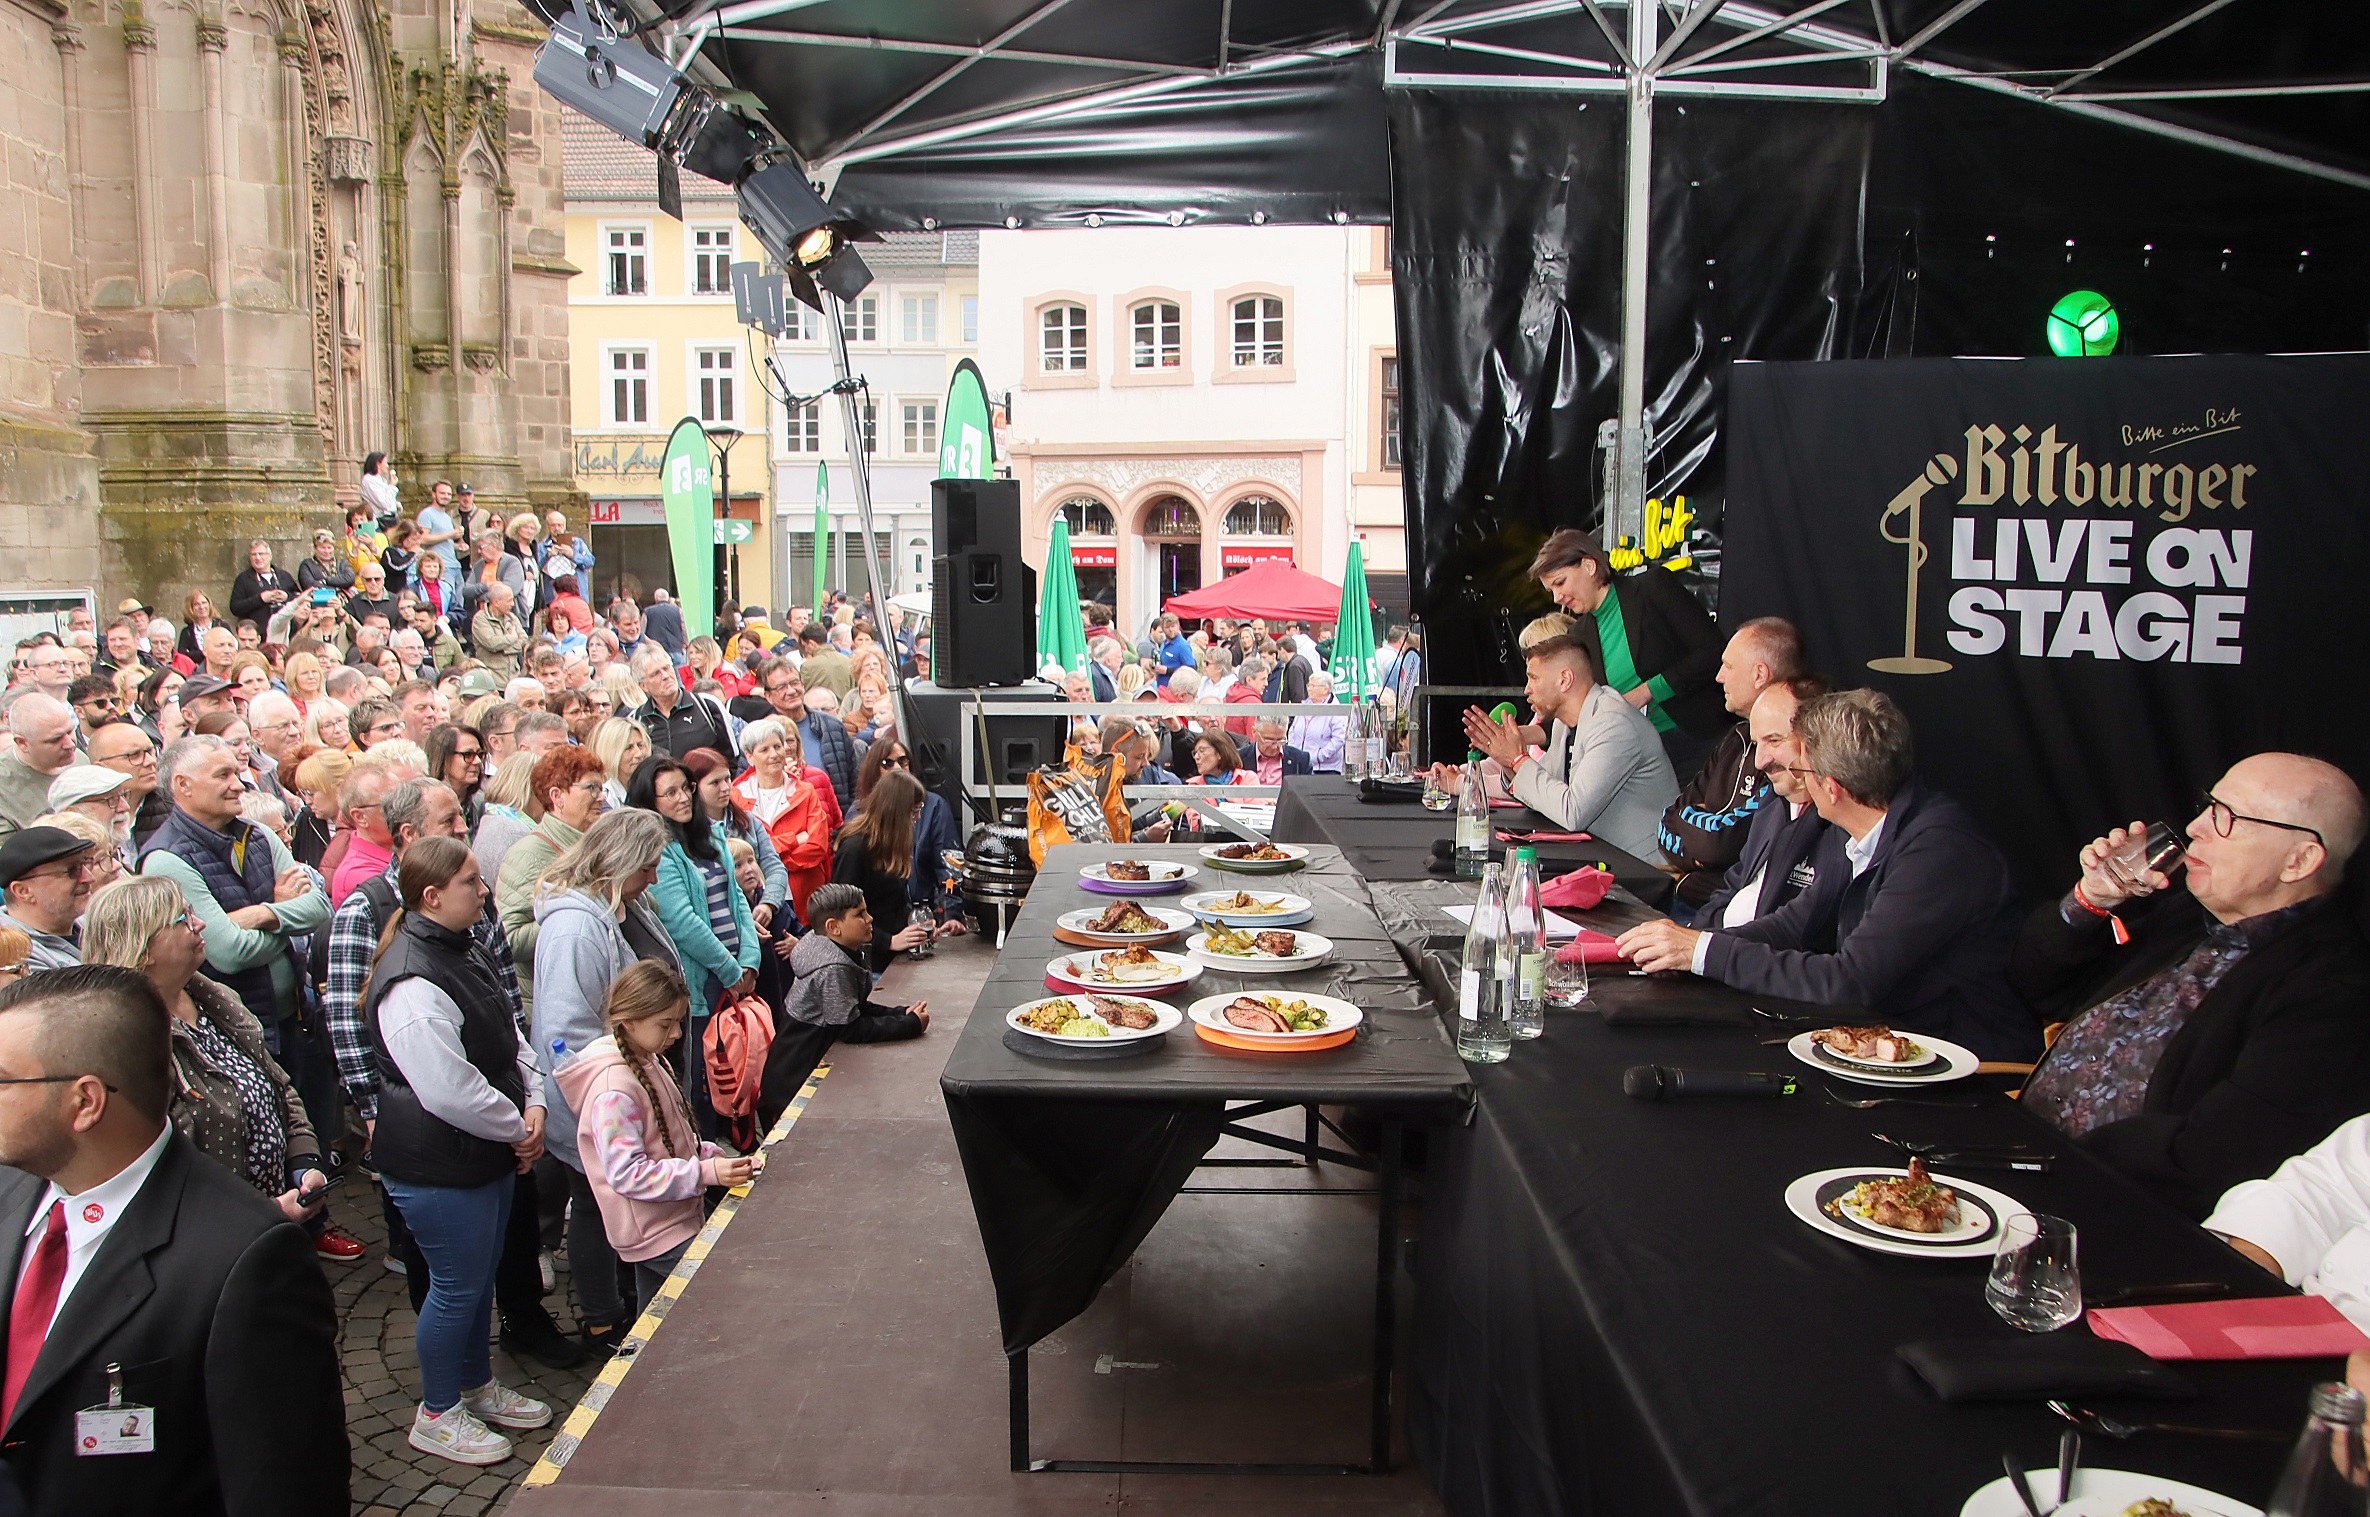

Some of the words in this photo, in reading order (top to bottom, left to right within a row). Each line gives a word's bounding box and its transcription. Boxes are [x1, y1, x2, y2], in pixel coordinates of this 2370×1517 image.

[579, 443, 618, 470] Carl
[623, 443, 663, 471] Au
[2121, 424, 2164, 446] Bitte
[2172, 424, 2200, 436] ein
[2205, 407, 2242, 429] Bit
[1956, 423, 2258, 522] Bitburger
[590, 501, 620, 522] LA
[1609, 535, 1644, 571] ein
[1645, 495, 1693, 559] Bit
[1951, 517, 2133, 584] LIVE
[2146, 527, 2252, 588] ON
[1946, 586, 2246, 664] STAGE
